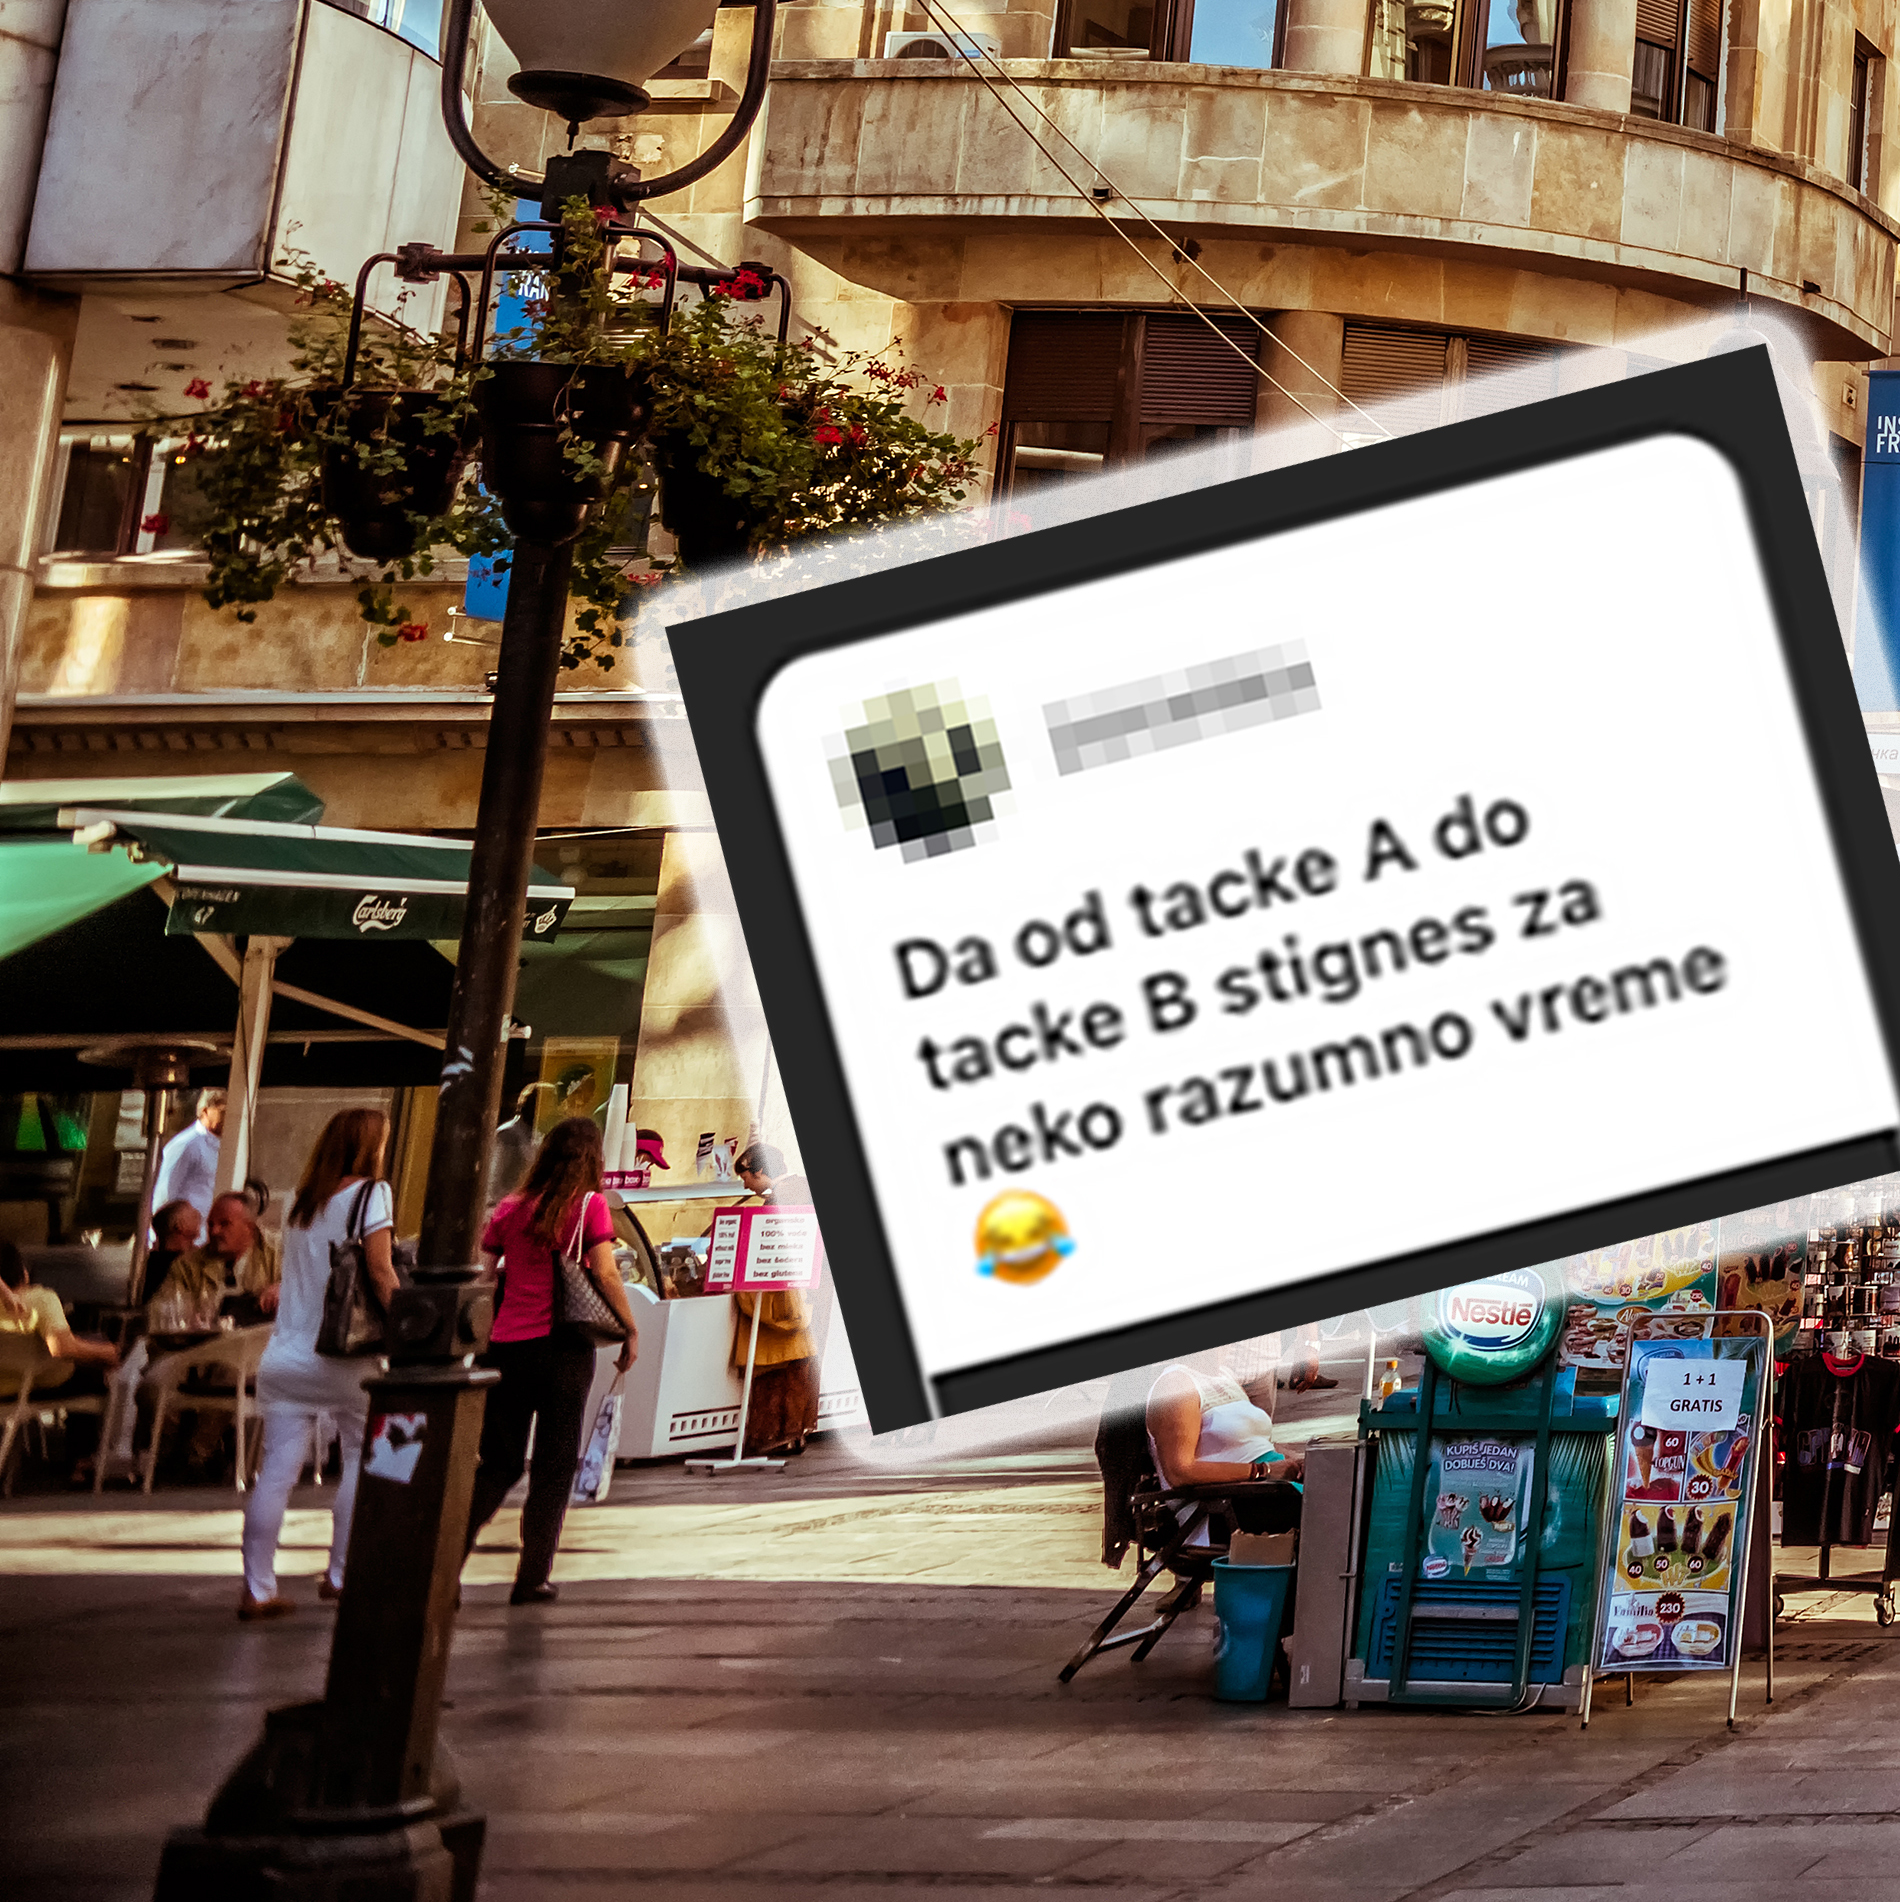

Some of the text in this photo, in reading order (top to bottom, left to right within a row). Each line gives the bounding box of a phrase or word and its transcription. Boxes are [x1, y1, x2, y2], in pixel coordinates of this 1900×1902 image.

[352, 895, 408, 929] Carlsberg
[753, 1270, 768, 1278] bez
[1670, 1399, 1723, 1413] GRATIS
[1665, 1438, 1679, 1447] 60
[1446, 1441, 1518, 1459] KUPIŠ JEDAN
[1488, 1459, 1516, 1473] DVA!
[1690, 1481, 1710, 1494] 30
[1628, 1565, 1642, 1575] 40
[1655, 1559, 1668, 1570] 50
[1689, 1559, 1702, 1570] 60
[1659, 1602, 1681, 1614] 230
